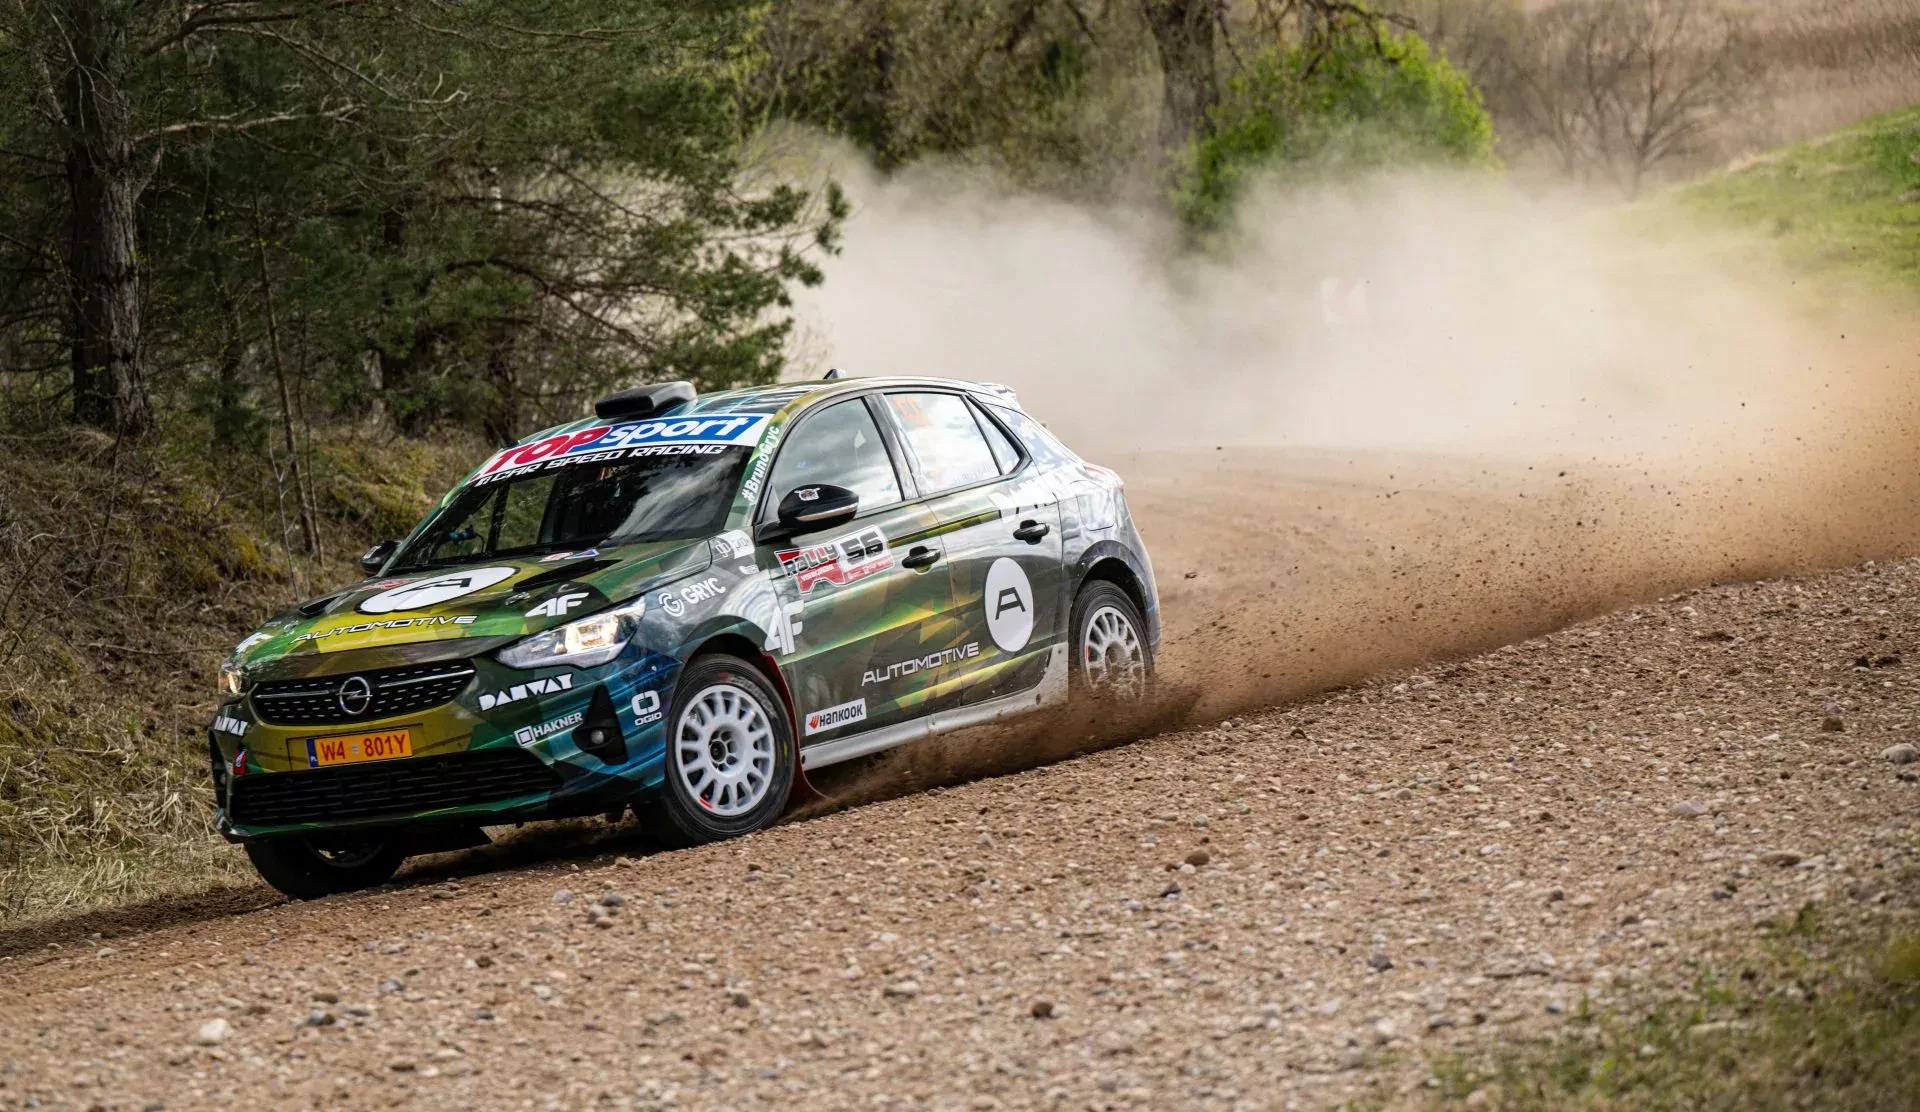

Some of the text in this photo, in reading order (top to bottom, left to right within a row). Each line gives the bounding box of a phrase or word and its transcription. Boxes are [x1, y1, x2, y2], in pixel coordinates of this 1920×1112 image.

[490, 463, 543, 482] CAR
[544, 450, 620, 470] SPEED
[631, 444, 726, 457] RACING
[681, 577, 727, 604] GRYC
[290, 615, 478, 643] AUTOMOTIVE
[861, 641, 980, 687] AUTOMOTIVE
[533, 712, 583, 738] HAKNER
[635, 712, 662, 726] OGIO
[363, 734, 406, 757] 801Y
